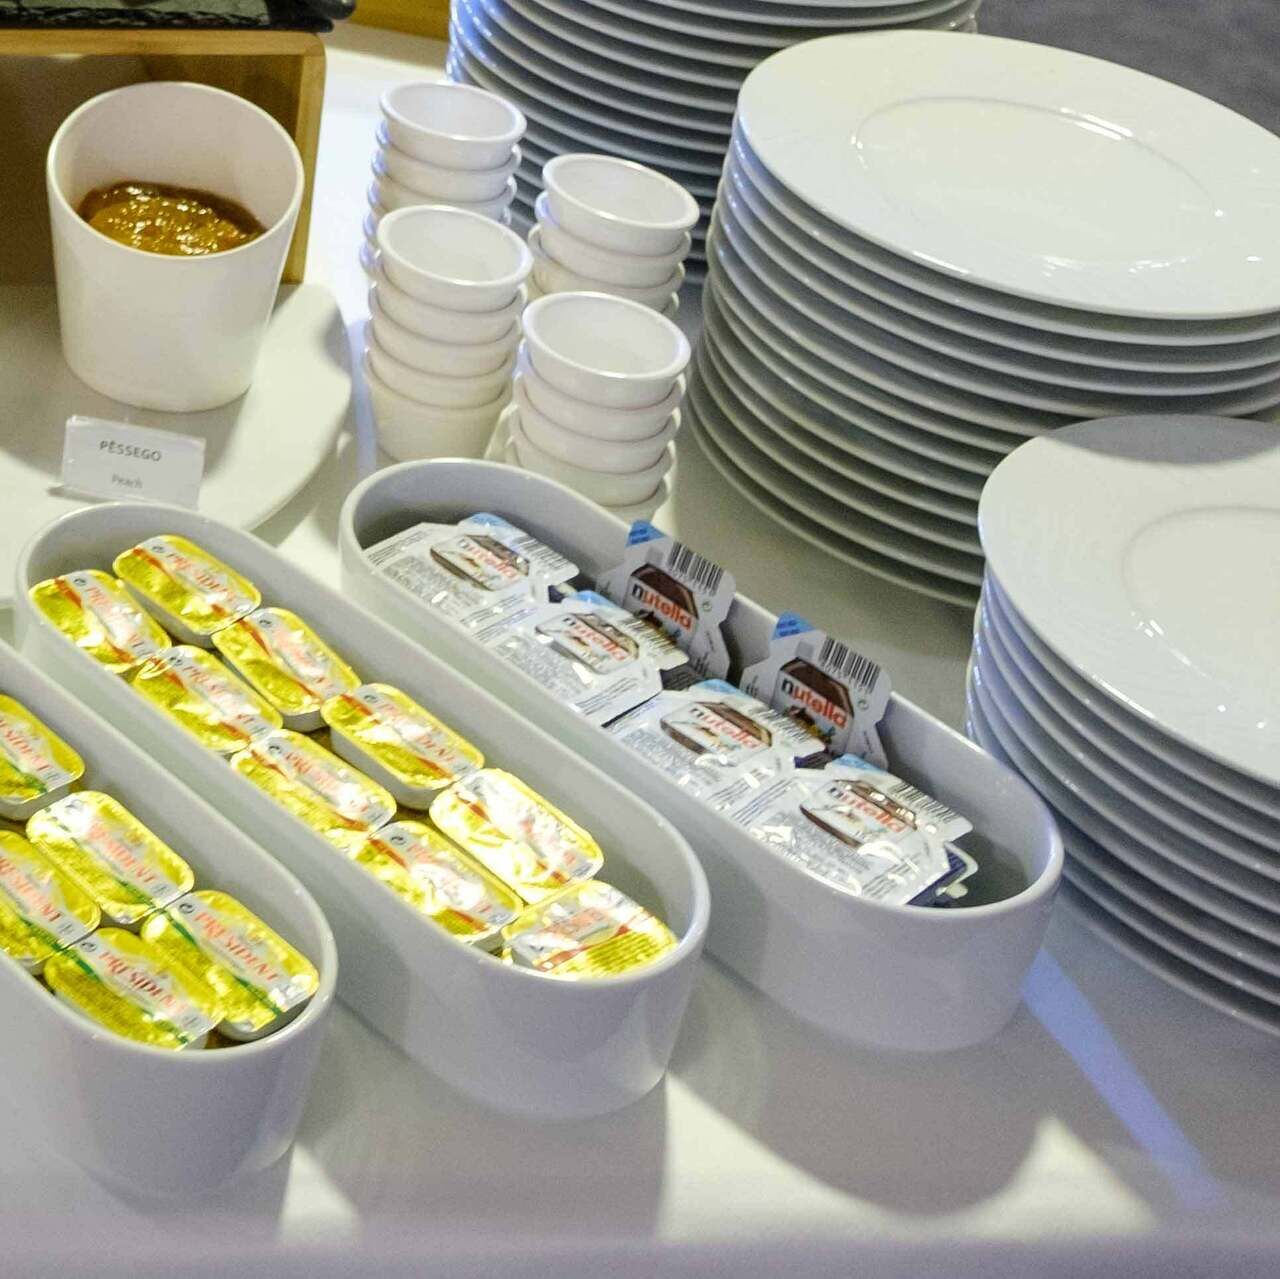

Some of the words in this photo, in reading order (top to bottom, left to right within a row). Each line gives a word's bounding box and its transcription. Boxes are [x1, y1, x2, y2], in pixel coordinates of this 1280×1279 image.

[111, 472, 143, 489] Peach
[459, 538, 519, 578] nutella
[631, 583, 693, 631] nutella
[562, 616, 627, 661] nutella
[781, 679, 847, 730] nutella
[688, 706, 761, 749] nutella
[827, 785, 905, 833] nutella
